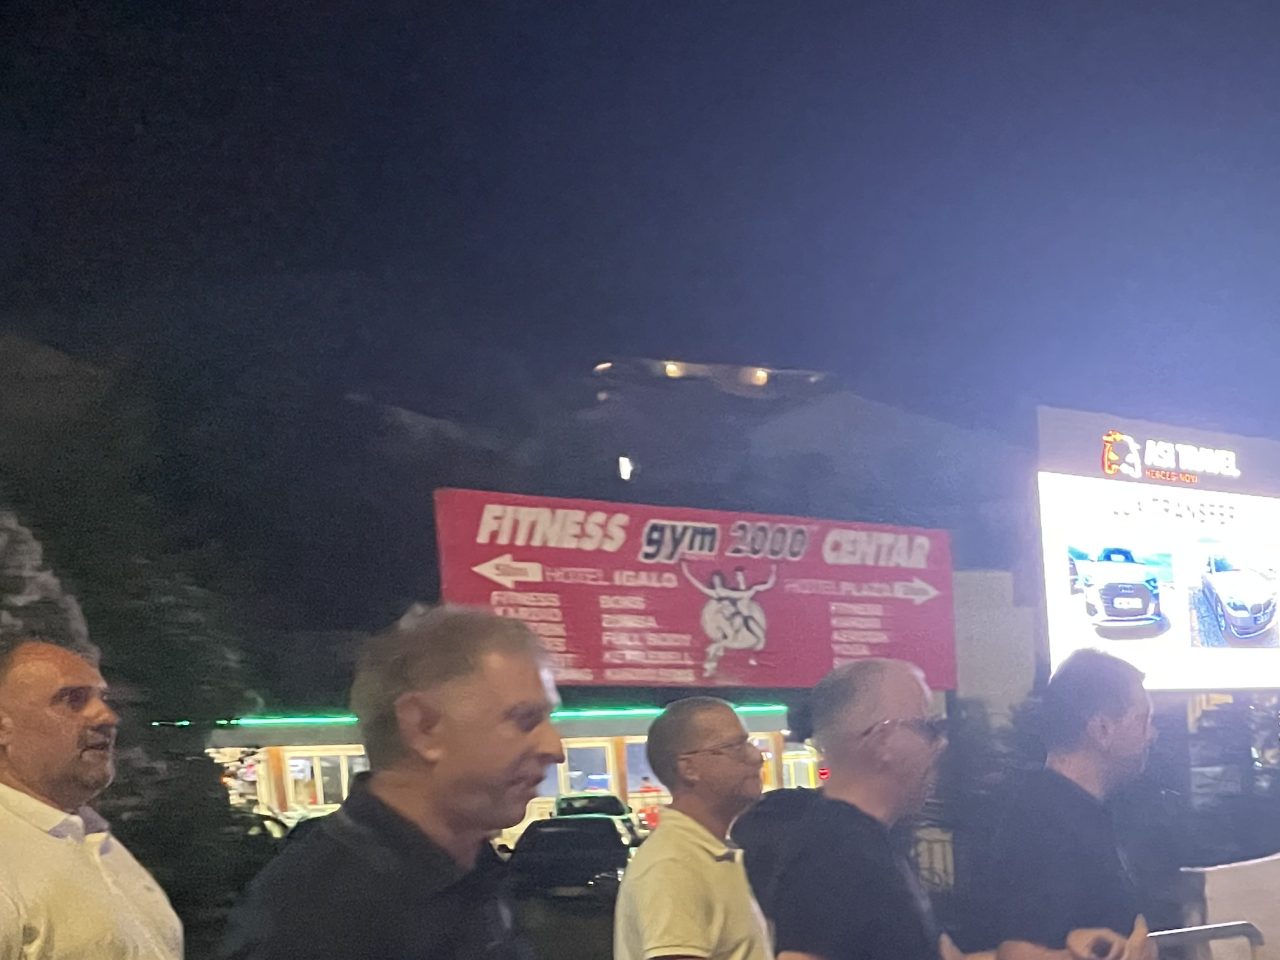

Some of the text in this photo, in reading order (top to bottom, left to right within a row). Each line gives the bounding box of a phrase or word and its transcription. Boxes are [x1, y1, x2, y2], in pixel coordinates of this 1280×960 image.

[476, 504, 931, 569] FITNESS gym 2000 CENTAR
[545, 567, 610, 585] HOTEL
[613, 569, 678, 588] IGALO
